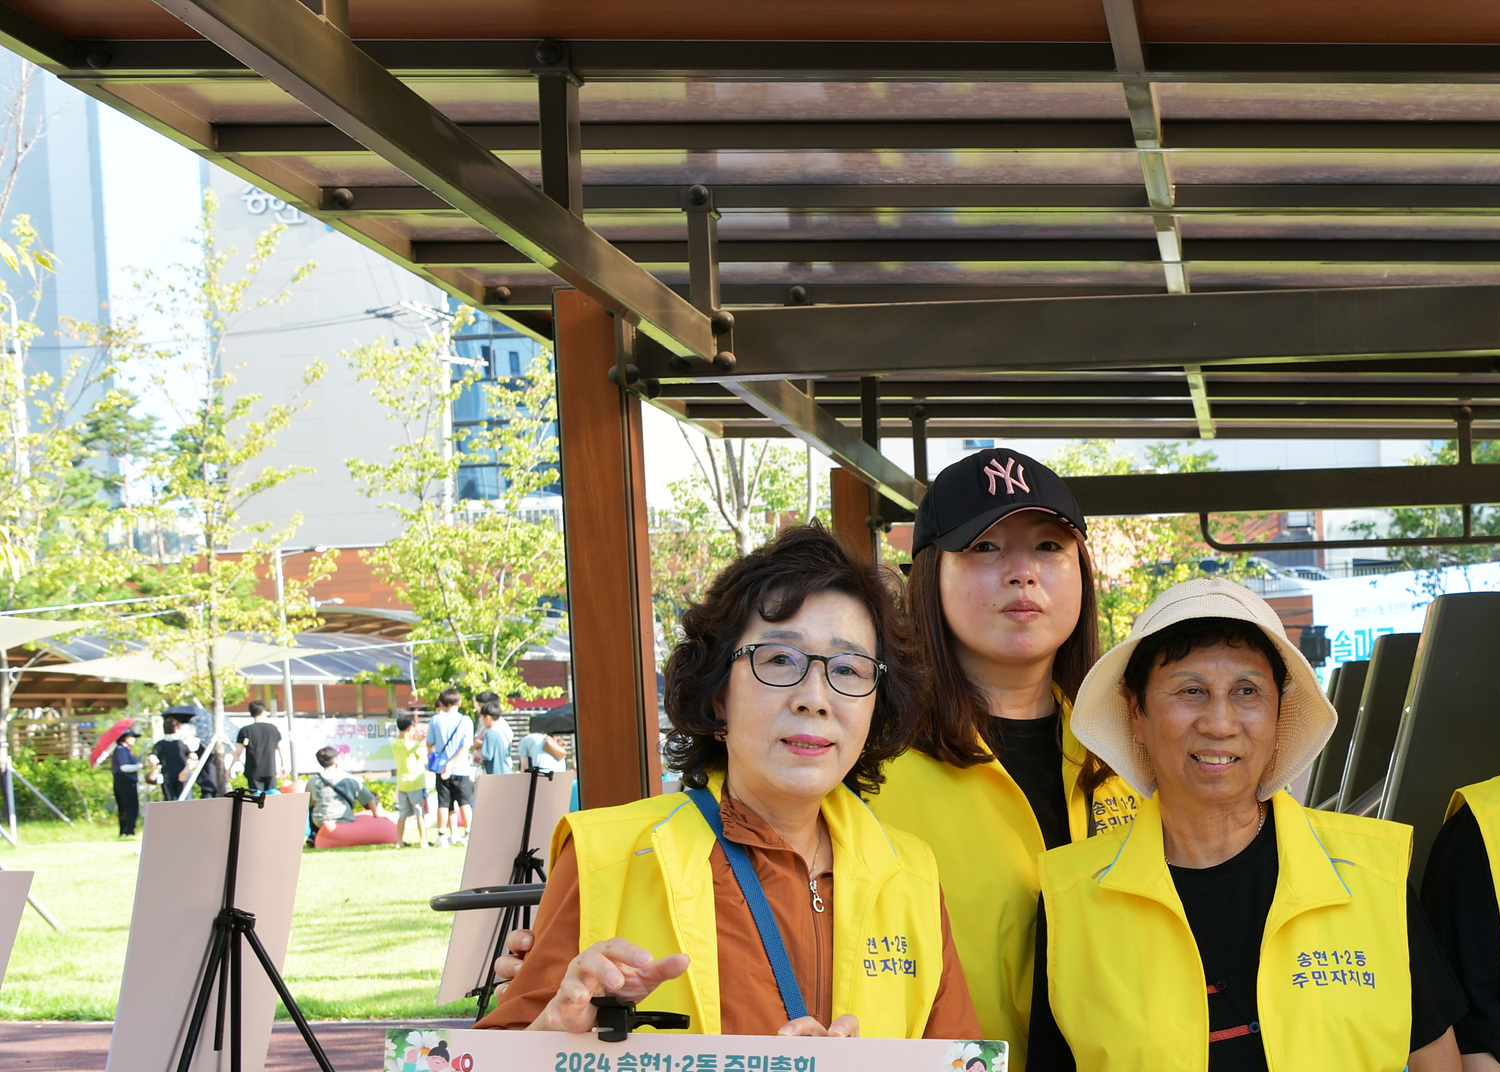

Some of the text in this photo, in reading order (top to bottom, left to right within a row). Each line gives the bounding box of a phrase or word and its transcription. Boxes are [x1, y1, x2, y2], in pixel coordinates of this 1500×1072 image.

[984, 457, 1030, 495] NY
[1297, 950, 1366, 967] 송현1·2동
[1292, 970, 1375, 989] 주민자치회
[555, 1052, 610, 1072] 2024
